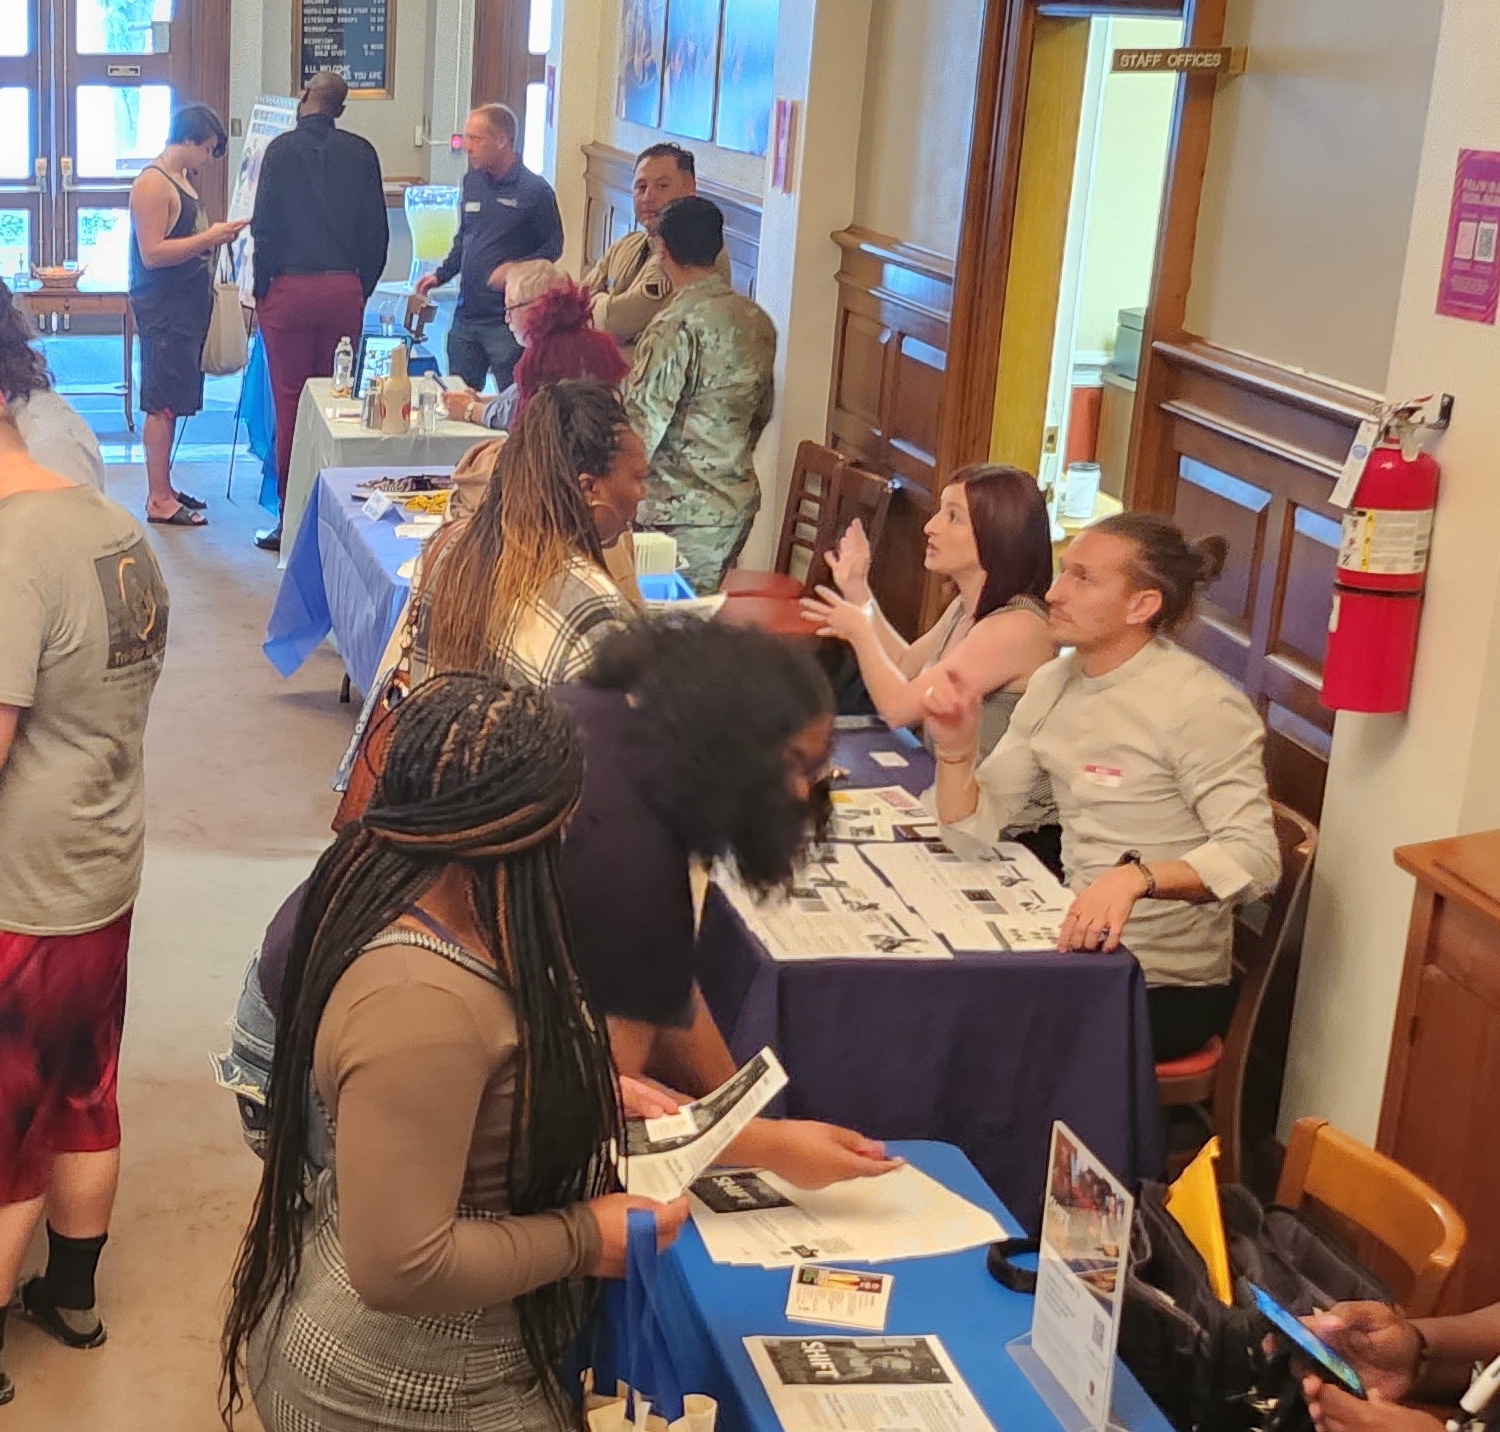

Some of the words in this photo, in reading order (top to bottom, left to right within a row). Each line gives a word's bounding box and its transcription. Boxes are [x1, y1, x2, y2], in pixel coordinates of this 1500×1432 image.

[1120, 52, 1163, 68] STAFF
[1167, 52, 1222, 67] OFFICES
[801, 1341, 840, 1380] SHIFT
